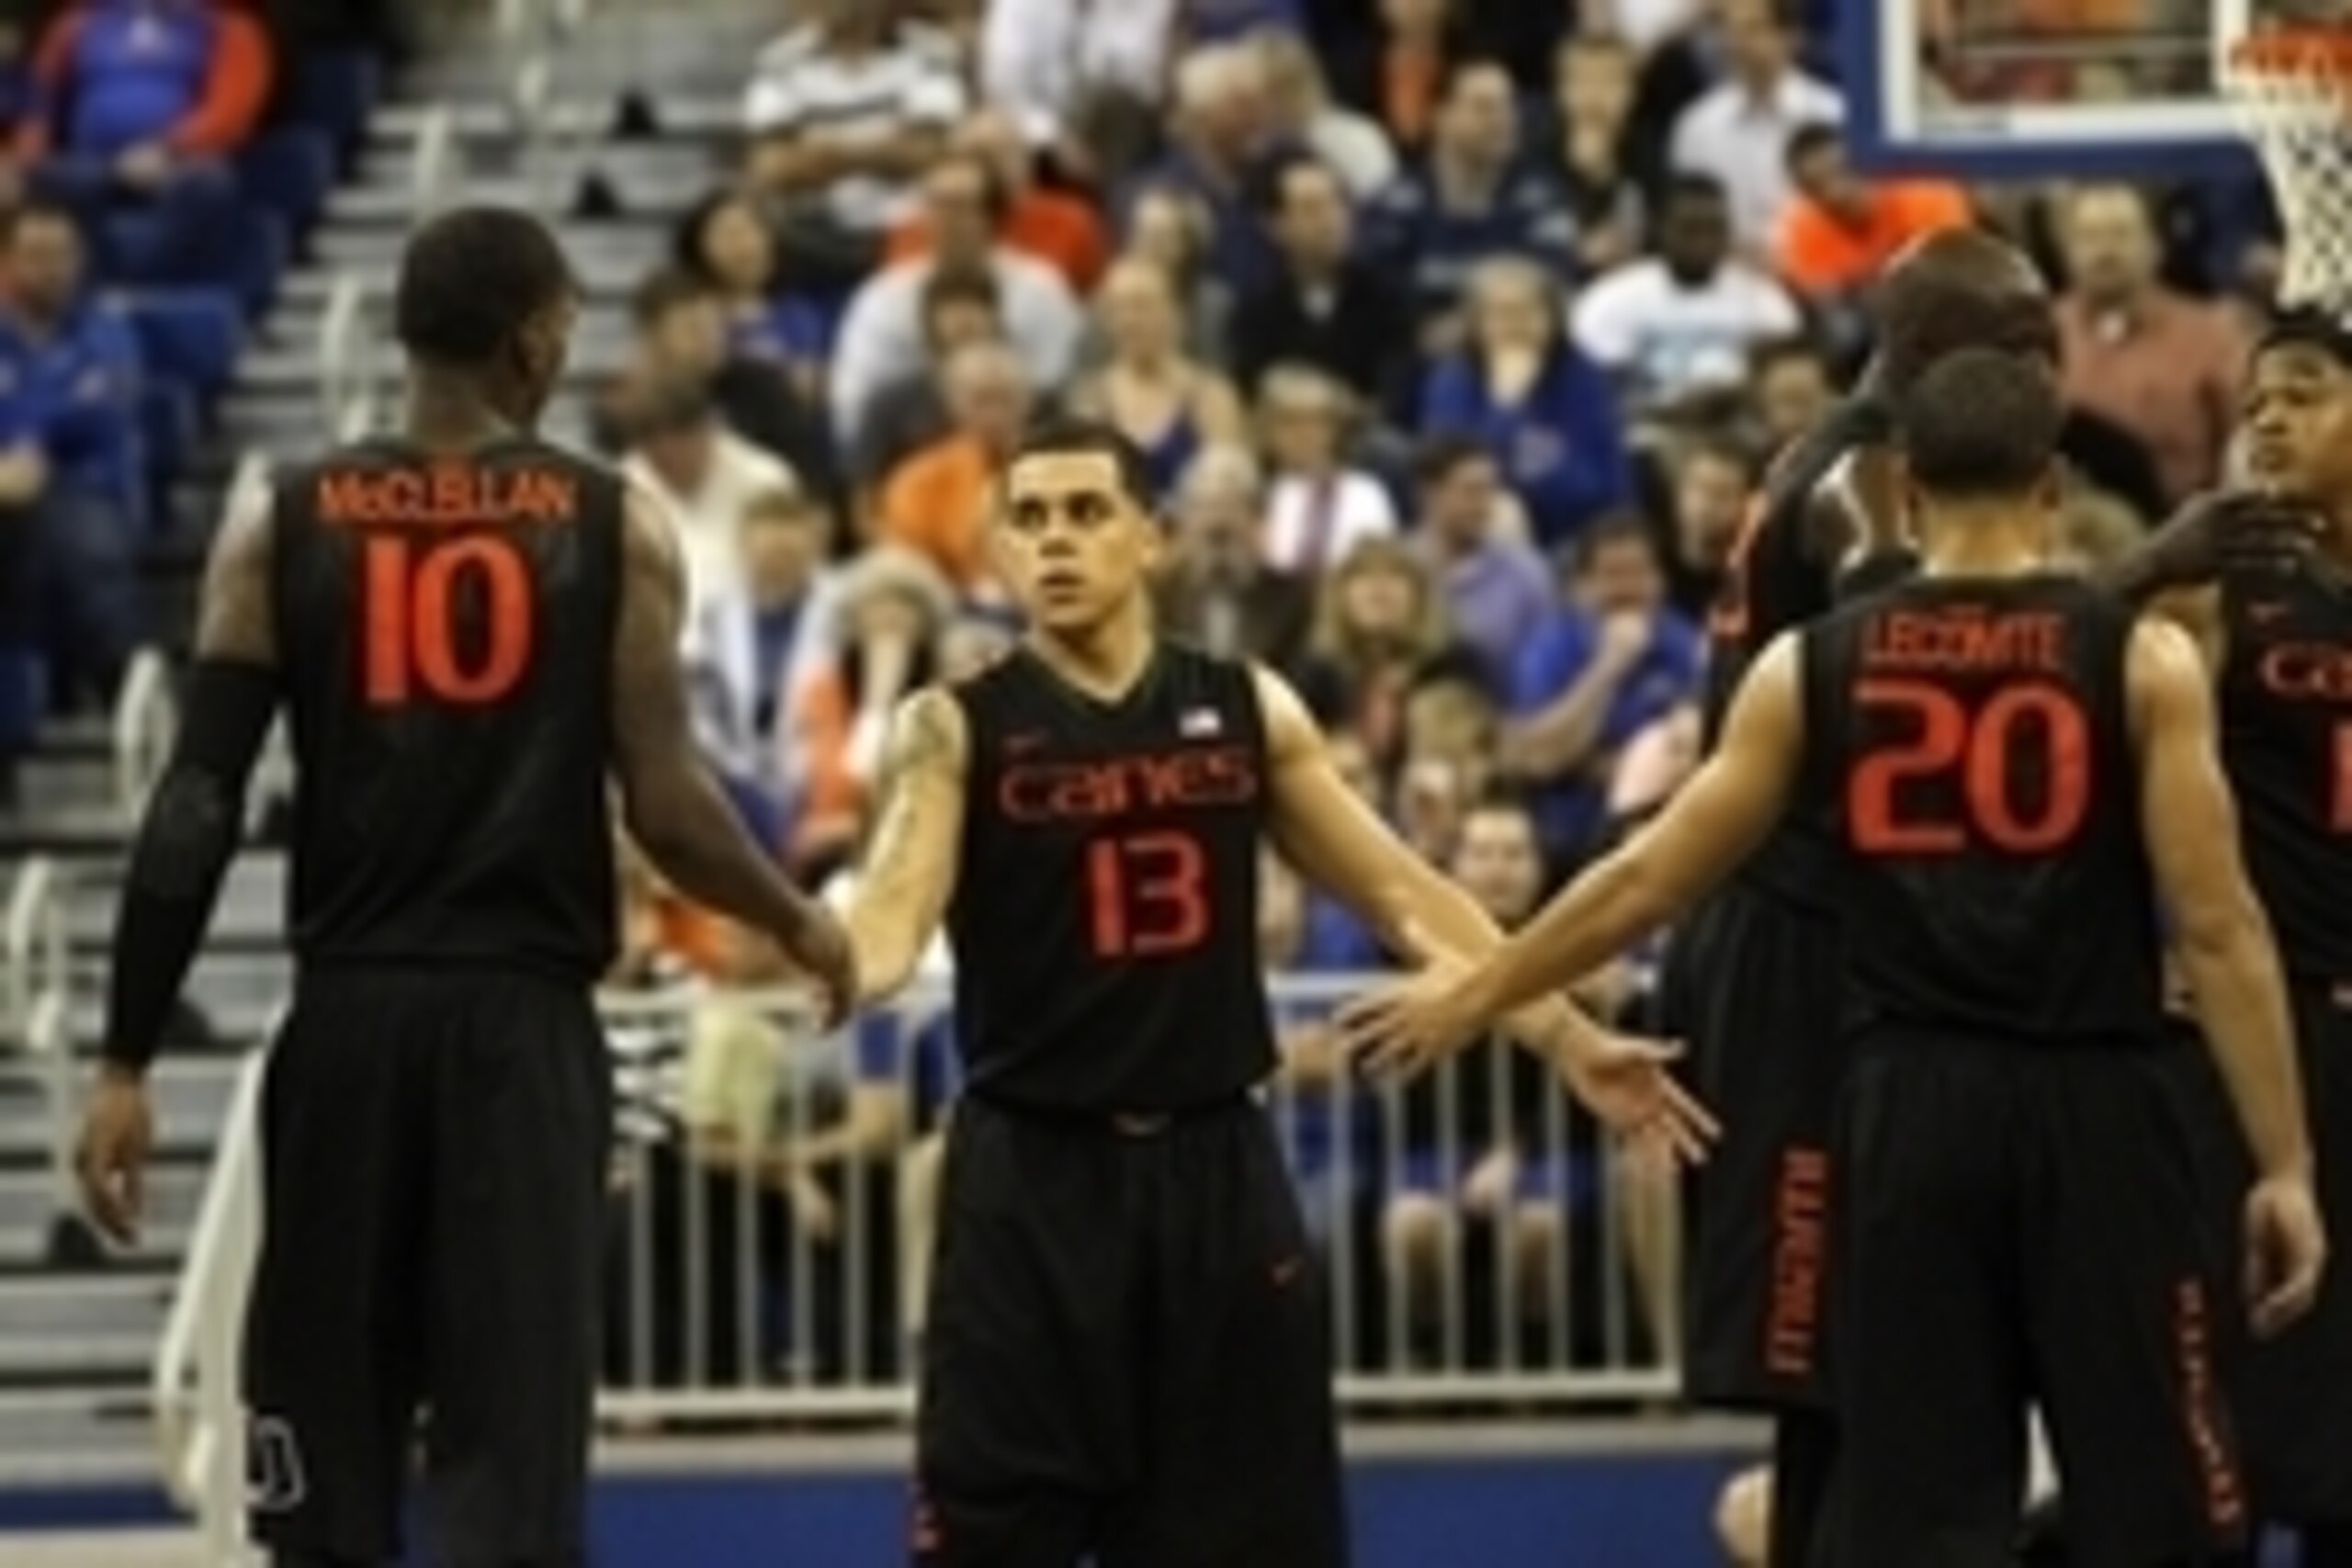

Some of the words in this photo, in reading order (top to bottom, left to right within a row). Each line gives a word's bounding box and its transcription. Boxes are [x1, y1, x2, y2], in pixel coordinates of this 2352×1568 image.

[365, 536, 533, 704] 10
[1850, 681, 2091, 852] 20
[1090, 832, 1211, 956] 13
